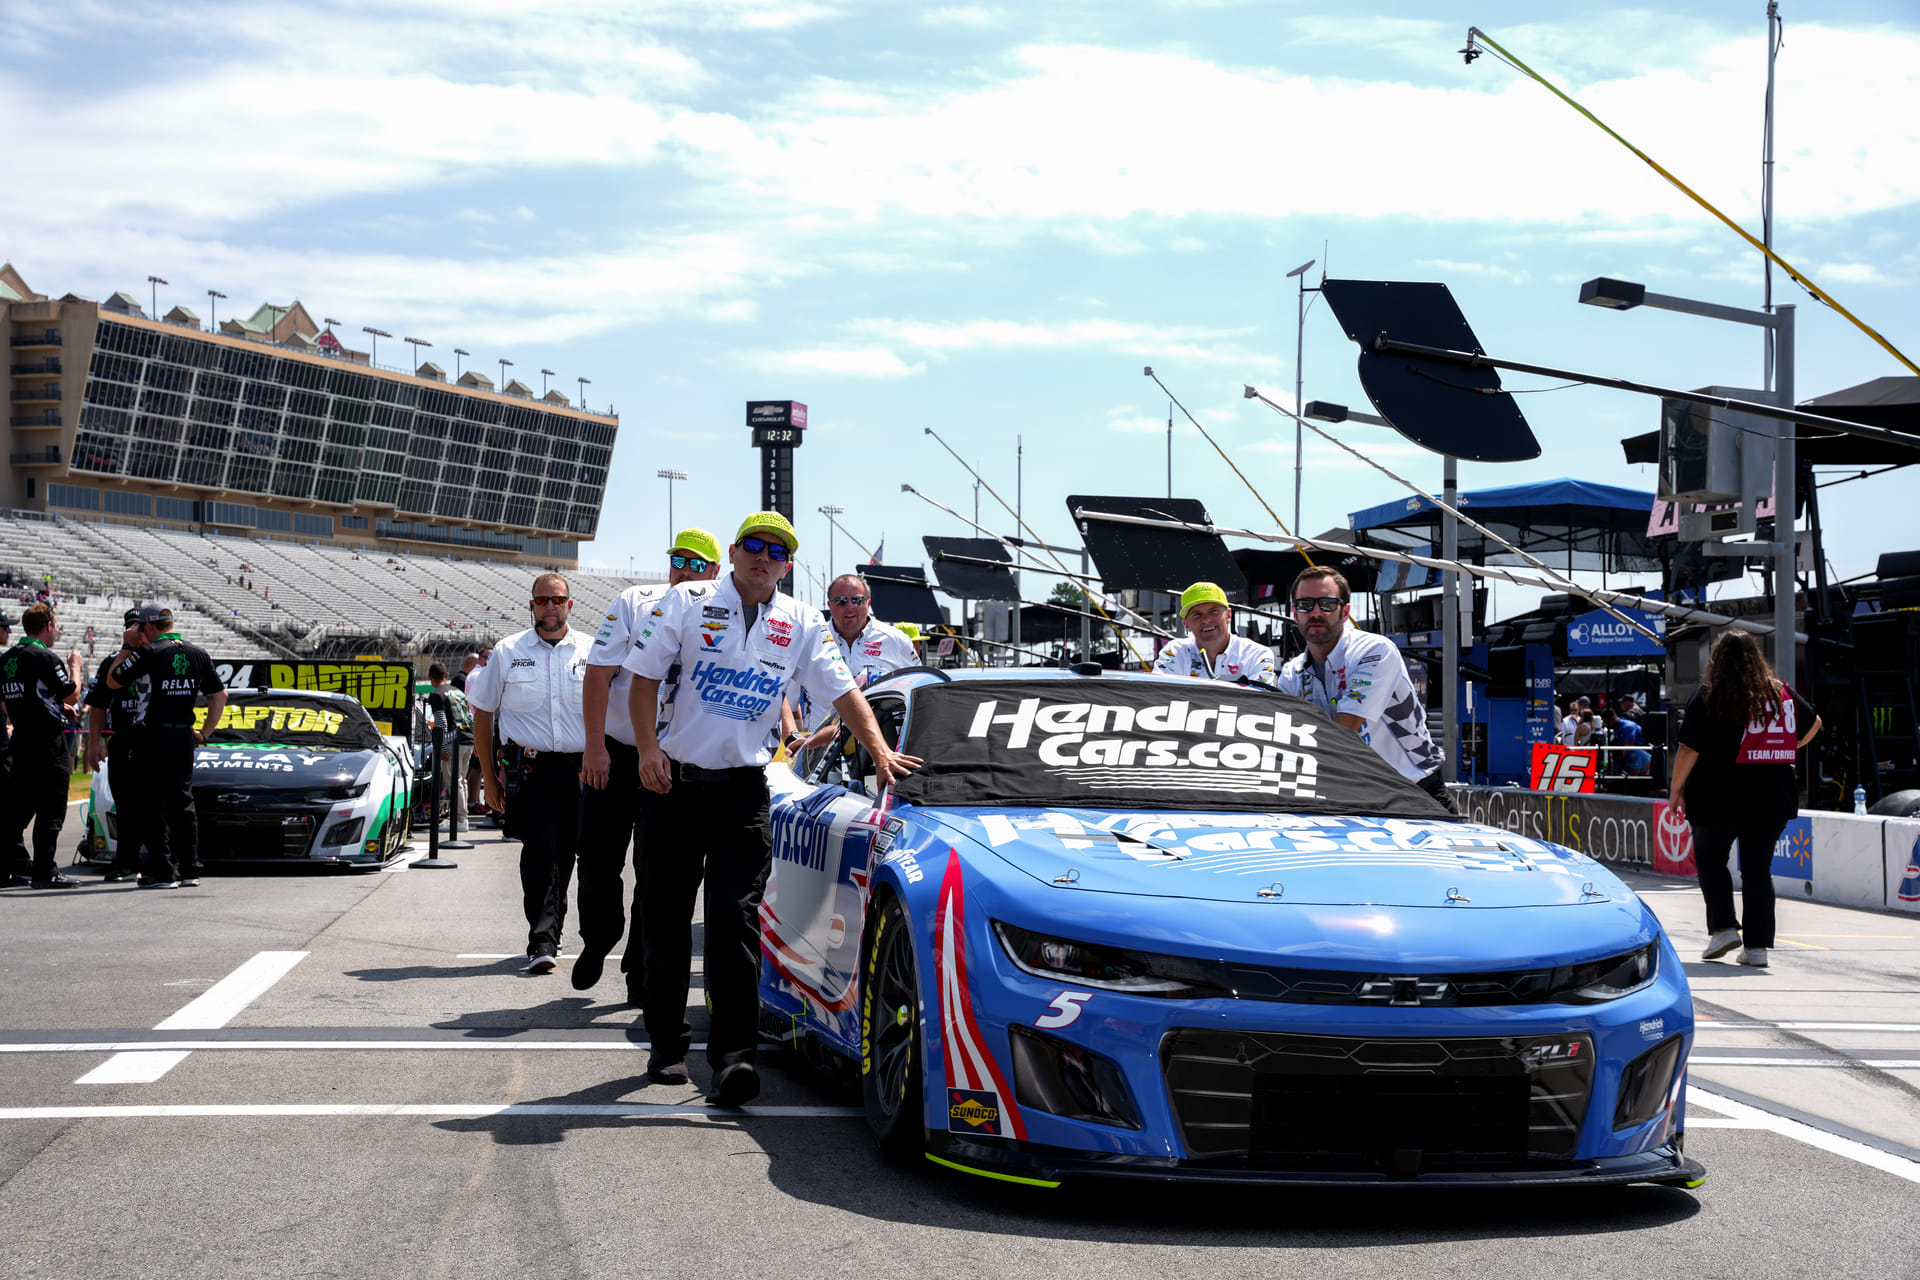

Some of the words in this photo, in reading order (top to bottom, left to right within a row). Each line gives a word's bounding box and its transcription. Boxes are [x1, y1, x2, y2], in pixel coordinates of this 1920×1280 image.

[767, 430, 792, 441] 12:32
[772, 449, 776, 457] 1
[770, 459, 776, 468] 2
[770, 472, 776, 480] 3
[770, 482, 776, 491] 4
[771, 495, 776, 503] 5
[1591, 623, 1634, 636] ALLOY
[161, 679, 196, 690] RELAY
[216, 664, 254, 689] 24
[270, 664, 410, 709] RAPTOR
[690, 660, 785, 698] Hendrick
[701, 684, 772, 713] Cars.com
[967, 698, 1318, 749] Hendrick
[196, 751, 326, 766] ELAY
[1038, 732, 1318, 777] Cars.com
[193, 760, 295, 772] AYMENTS
[1537, 752, 1592, 793] 16
[1033, 990, 1096, 1030] 5
[1526, 1042, 1581, 1061] ZL1
[951, 1105, 997, 1121] SUNOCO
